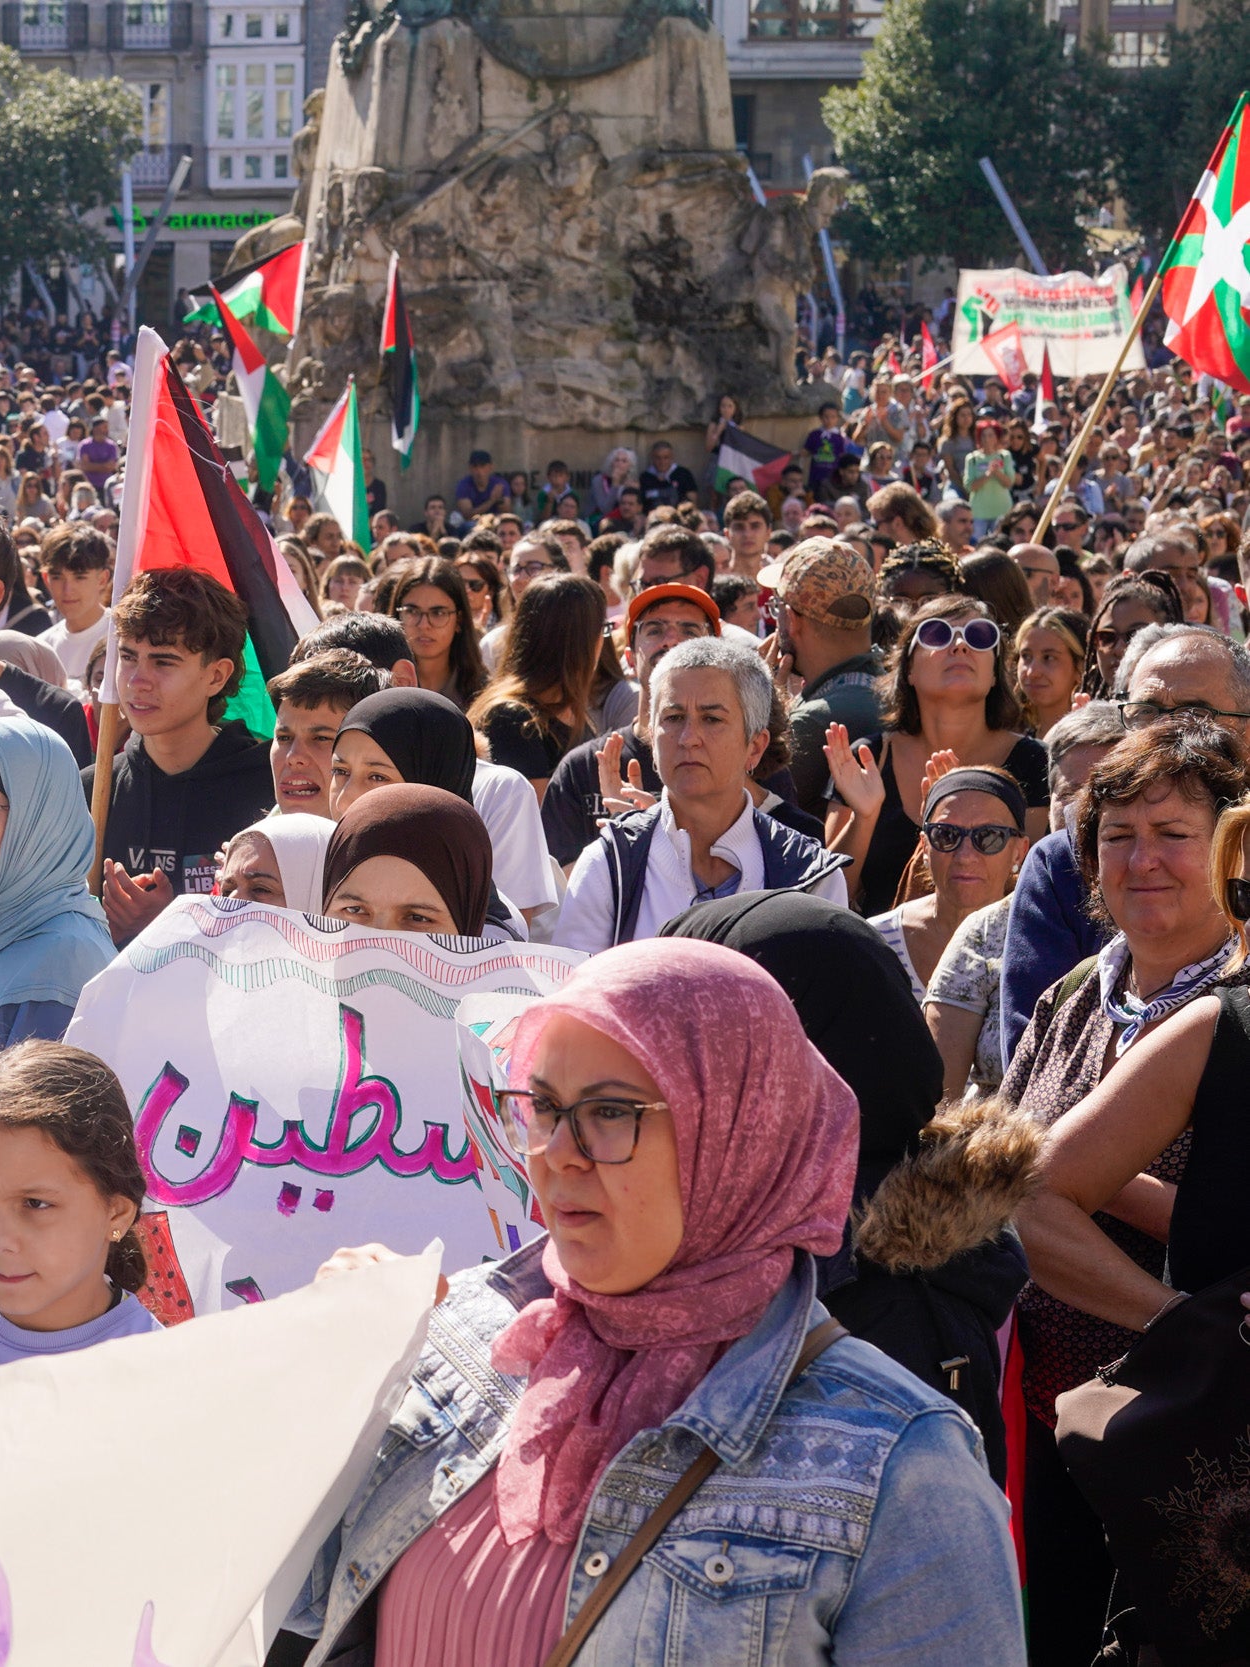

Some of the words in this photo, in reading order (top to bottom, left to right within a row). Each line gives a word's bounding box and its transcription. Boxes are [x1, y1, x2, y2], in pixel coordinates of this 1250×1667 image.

[153, 207, 275, 230] armacia
[184, 866, 222, 877] PALES
[184, 878, 213, 893] LIB
